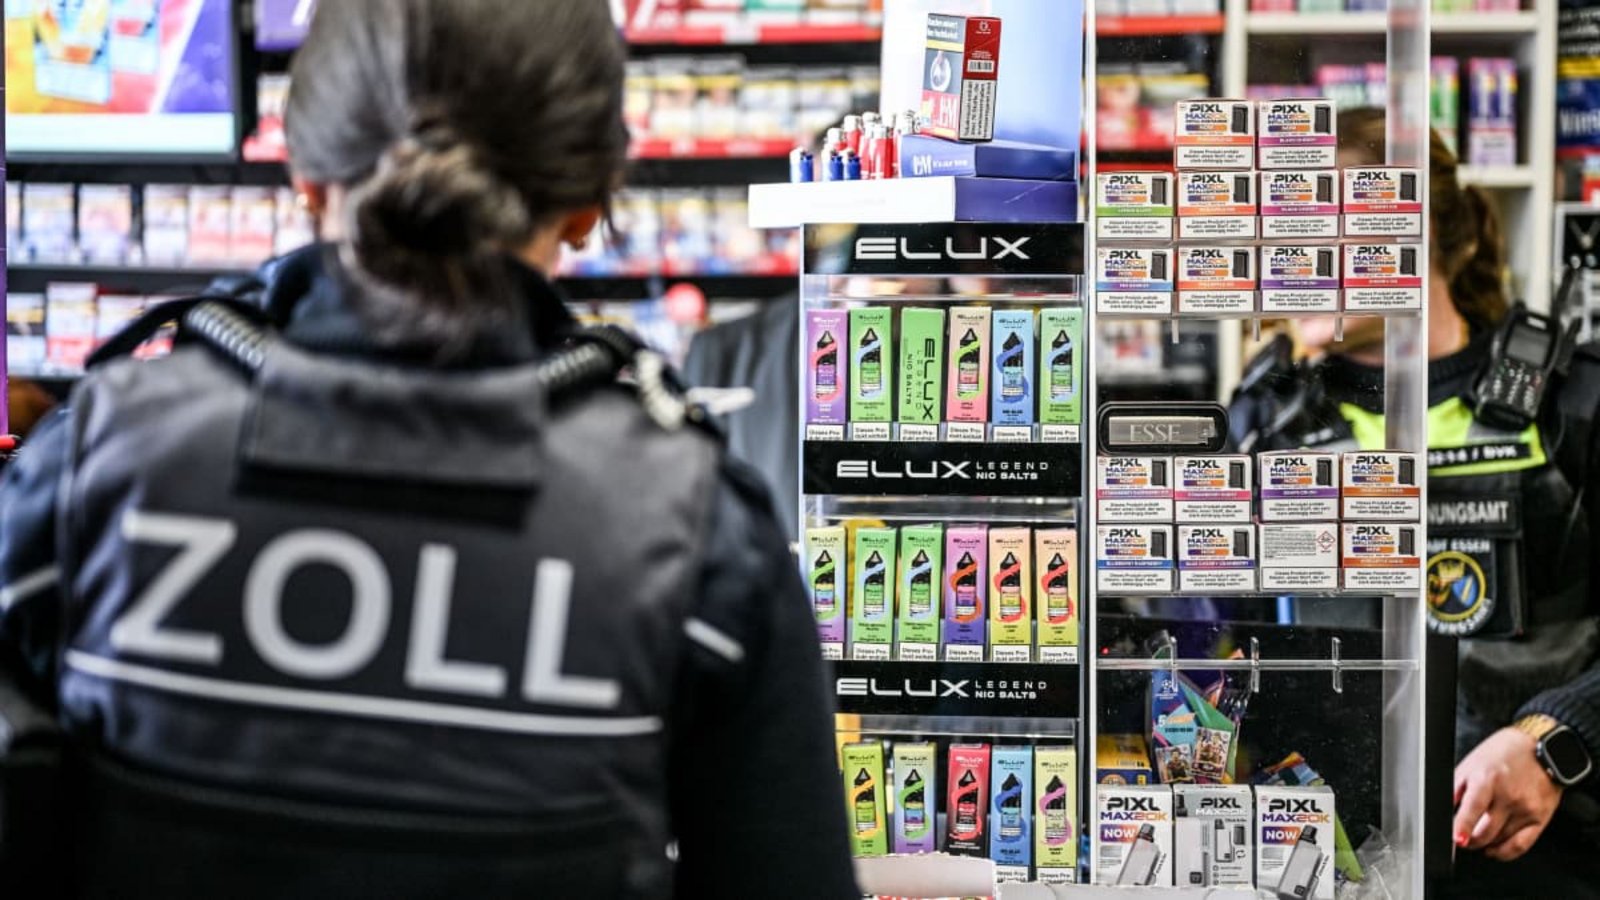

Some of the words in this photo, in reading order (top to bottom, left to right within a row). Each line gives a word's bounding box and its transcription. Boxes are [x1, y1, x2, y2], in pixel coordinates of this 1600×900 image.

[1189, 104, 1223, 113] PIXL
[1272, 104, 1306, 114] PIXL
[1109, 175, 1143, 184] PIXL
[1191, 175, 1225, 183] PIXL
[1274, 174, 1308, 183] PIXL
[1357, 172, 1391, 181] PIXL
[855, 236, 1031, 260] ELUX
[1274, 248, 1308, 257] PIXL
[1357, 247, 1391, 255] PIXL
[1109, 251, 1142, 260] PIXL
[1191, 249, 1224, 258] PIXL
[922, 338, 935, 420] ELUX
[1130, 424, 1181, 442] ESSE
[1109, 458, 1142, 467] PIXL
[1187, 460, 1220, 468] PIXL
[1274, 458, 1308, 466] PIXL
[1355, 456, 1389, 465] PIXL
[836, 460, 971, 478] ELUX
[976, 462, 1049, 470] LEGEND
[976, 471, 996, 480] NIC
[1000, 471, 1038, 480] SALTS
[1109, 529, 1142, 538] PIXL
[1191, 529, 1224, 538] PIXL
[1356, 526, 1390, 535] PIXL
[110, 508, 620, 707] ZOLL
[836, 678, 970, 697] ELUX
[975, 680, 1047, 690] LEGEND
[975, 690, 995, 698] NIC
[999, 690, 1037, 700] SALTS
[1107, 797, 1159, 811] PIXL
[1201, 797, 1242, 809] PIXL
[1269, 799, 1323, 813] PIXL
[1100, 812, 1168, 821] MAX20K
[1262, 813, 1330, 823] MAX20K
[1104, 829, 1136, 838] NOW
[1266, 830, 1298, 840] NOW
